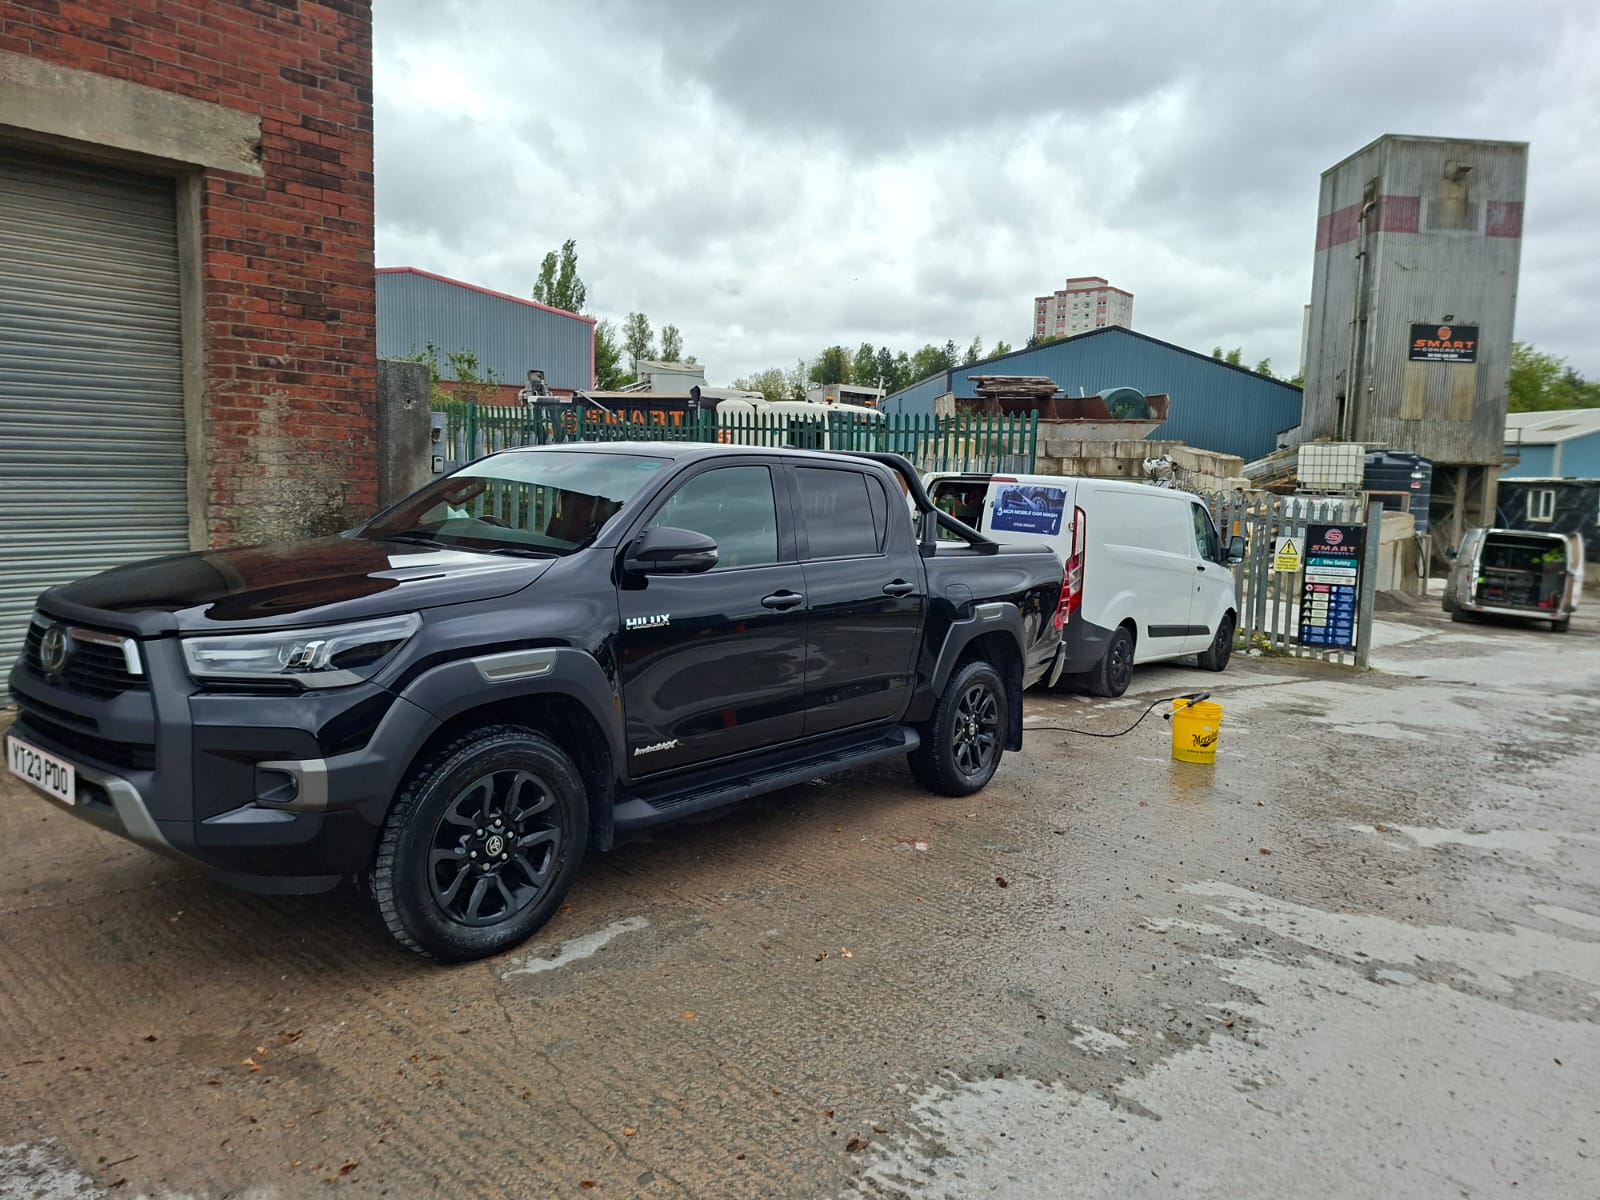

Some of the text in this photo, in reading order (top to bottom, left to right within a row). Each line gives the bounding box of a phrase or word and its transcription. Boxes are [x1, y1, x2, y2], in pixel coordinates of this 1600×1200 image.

[1413, 339, 1474, 348] SMART
[1311, 544, 1356, 552] SMART
[626, 613, 670, 630] HILUX
[12, 743, 68, 795] YT23 PDO
